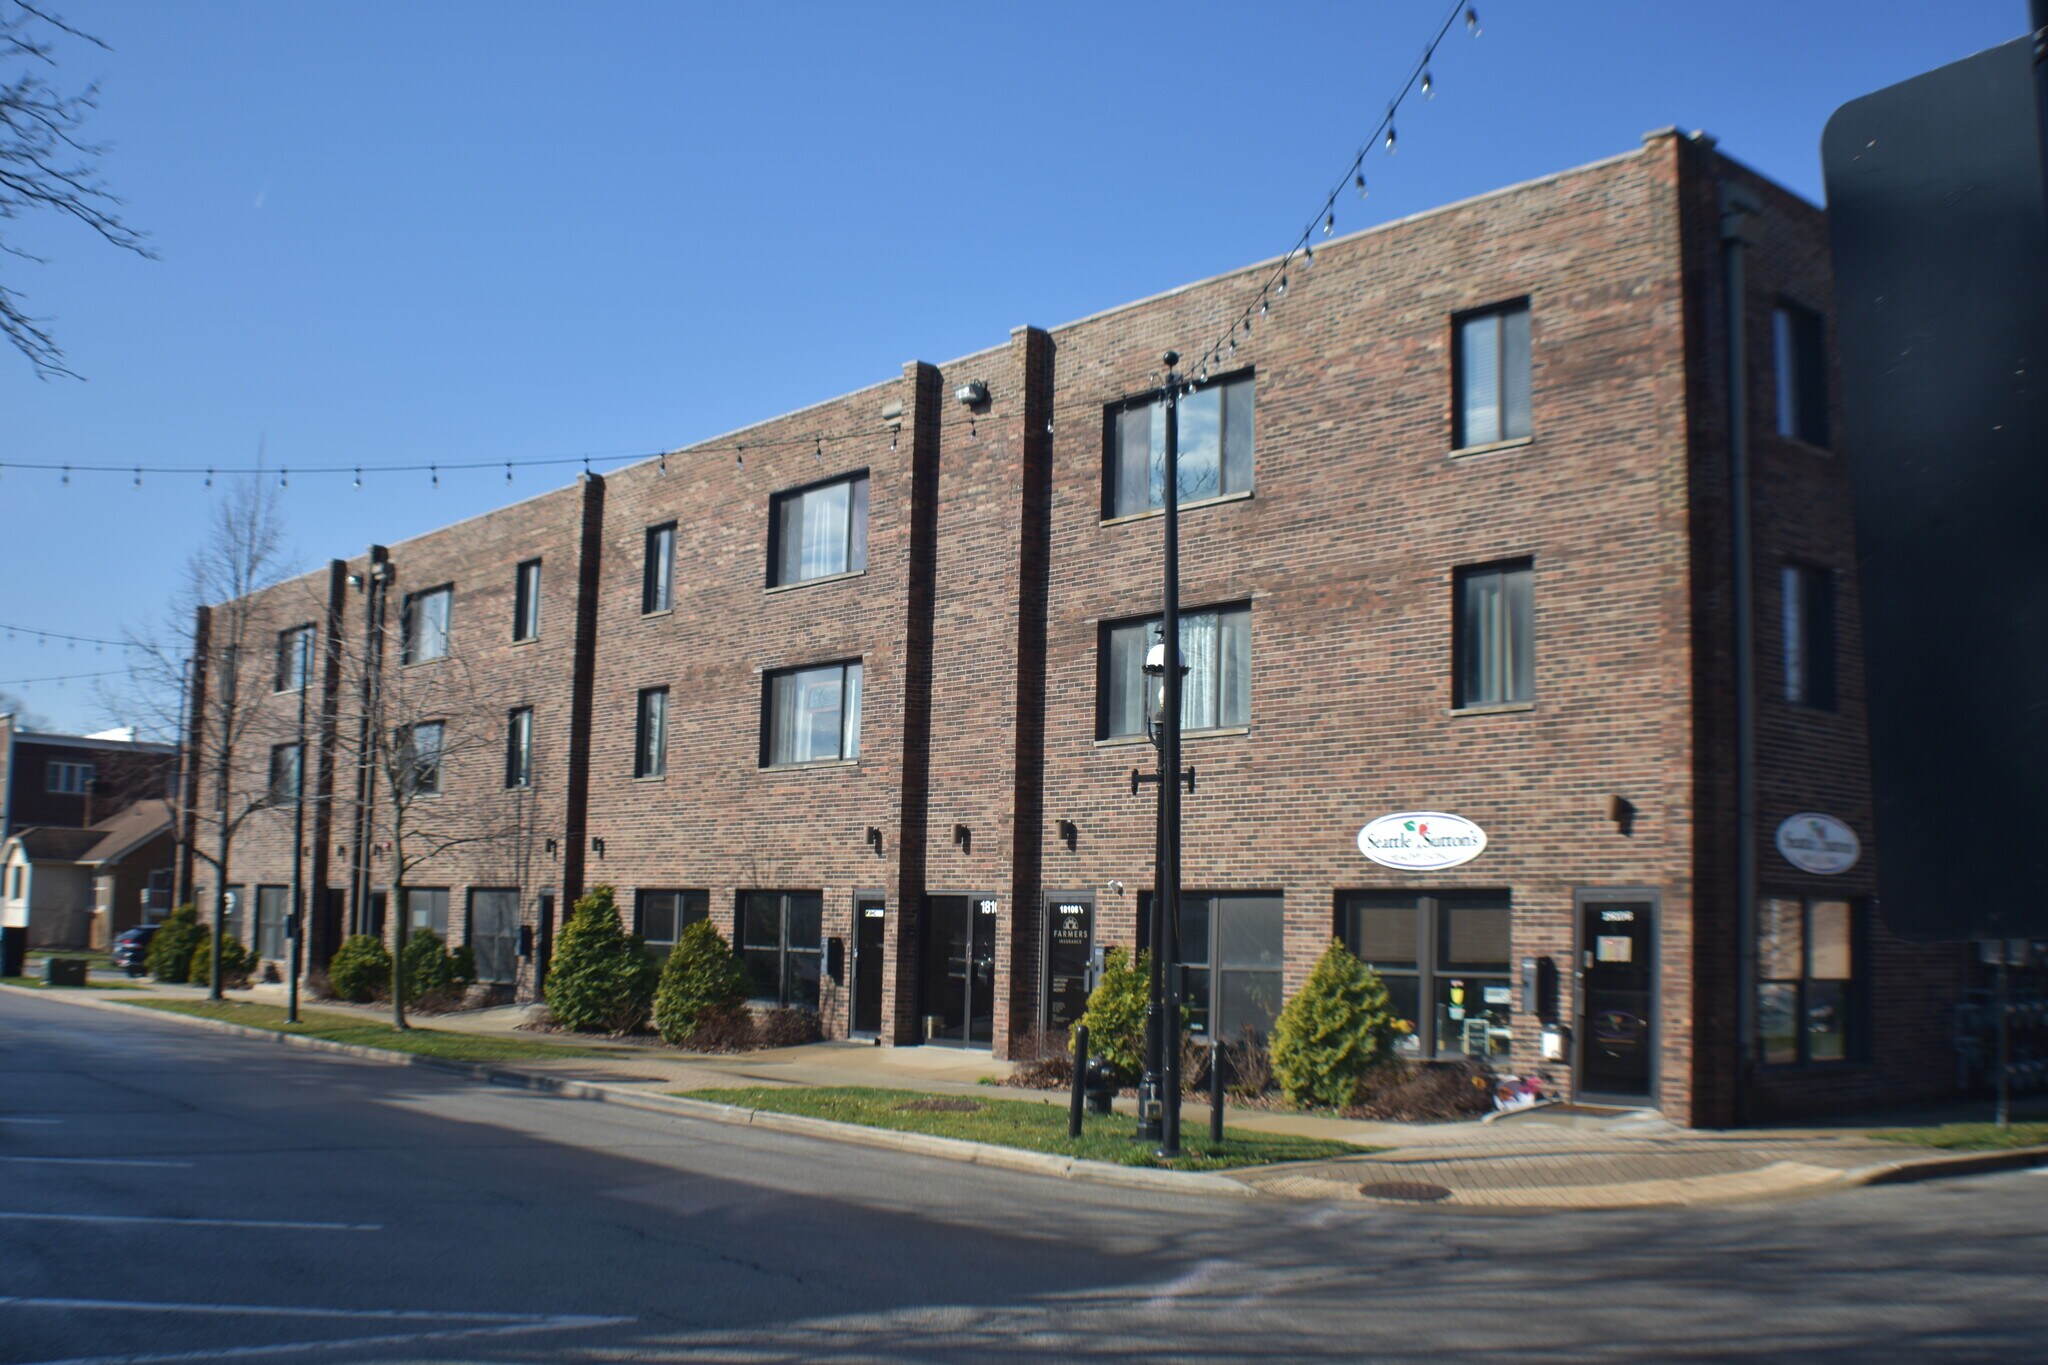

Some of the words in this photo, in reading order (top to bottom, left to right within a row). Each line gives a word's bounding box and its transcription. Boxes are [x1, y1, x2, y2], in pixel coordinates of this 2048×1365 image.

[1367, 832, 1413, 850] Seattle
[1422, 830, 1479, 849] Sutton's
[1053, 929, 1088, 938] FARMERS
